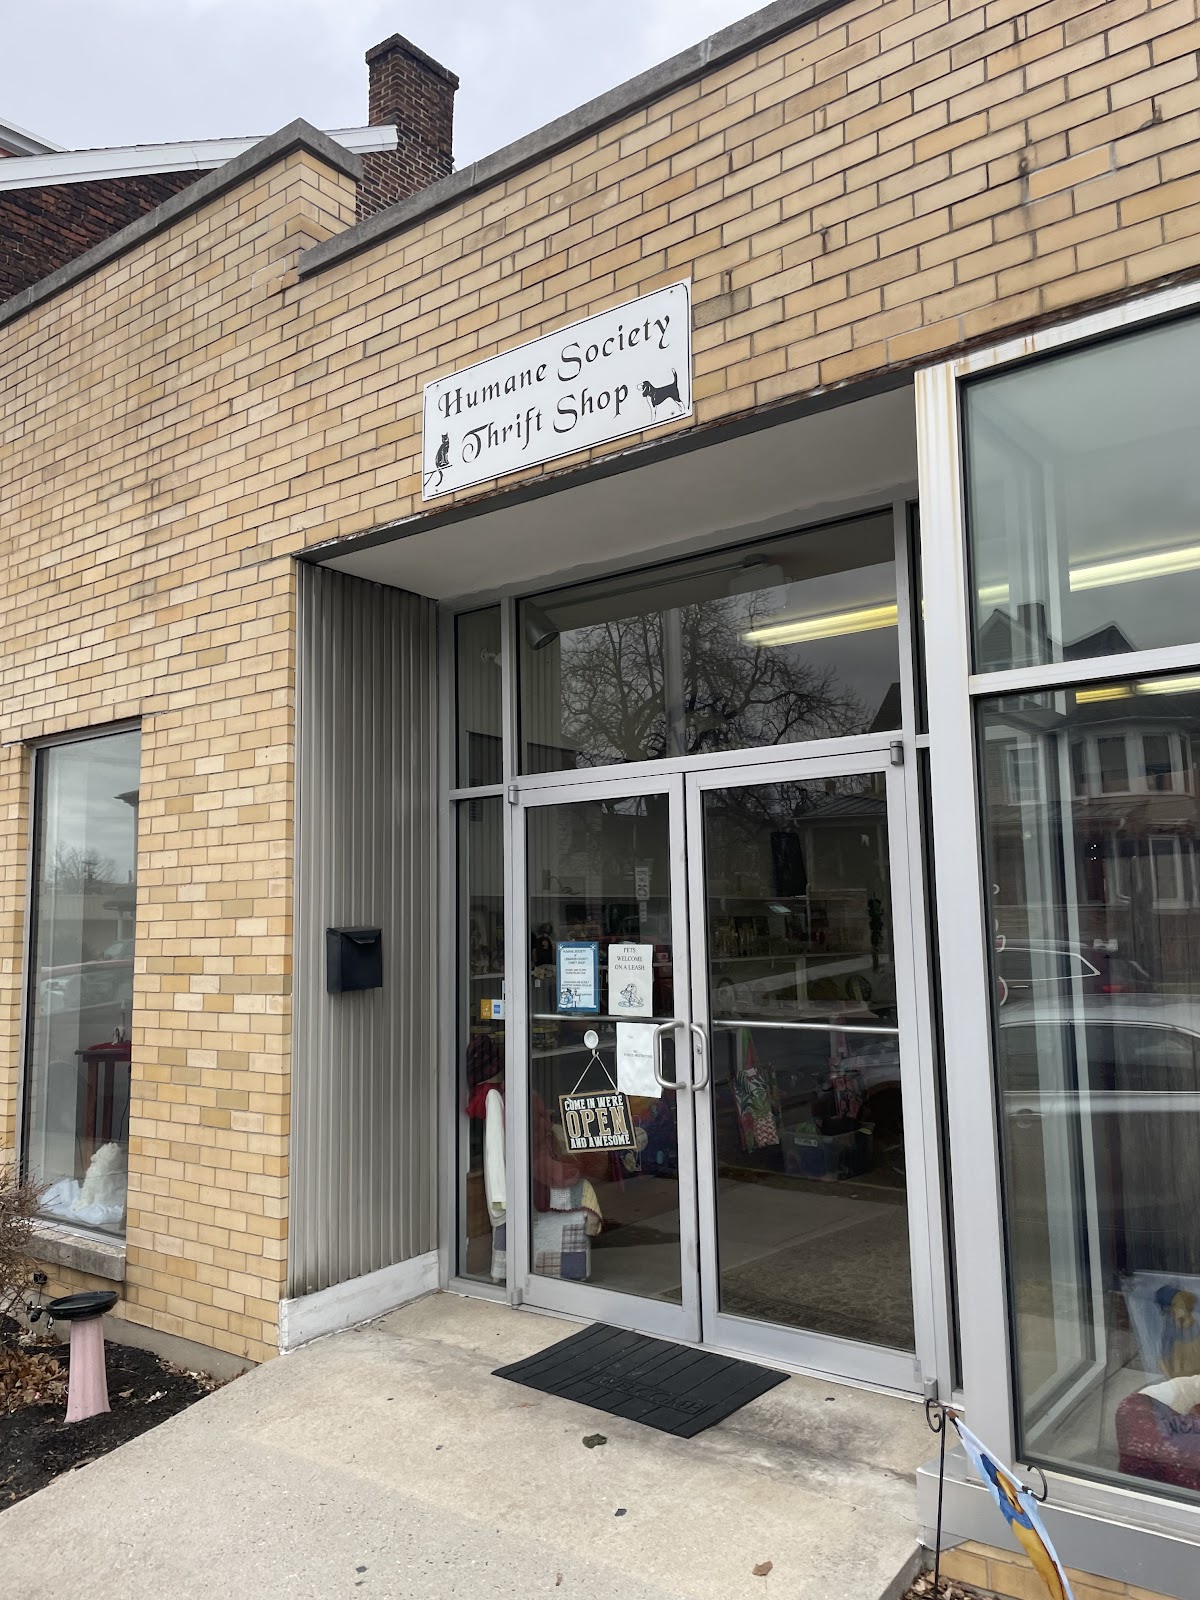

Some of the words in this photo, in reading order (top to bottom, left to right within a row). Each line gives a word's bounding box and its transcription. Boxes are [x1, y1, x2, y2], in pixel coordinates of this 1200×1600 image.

[438, 363, 547, 418] Humane
[557, 315, 670, 382] Society
[461, 407, 543, 463] Thrift
[553, 384, 629, 433] Shop
[564, 1099, 586, 1111] COME
[586, 1097, 596, 1109] IN
[566, 1106, 629, 1138] OPEN
[571, 1137, 587, 1149] AND
[589, 1134, 631, 1147] AWESOME
[598, 1376, 704, 1411] WELCOME
